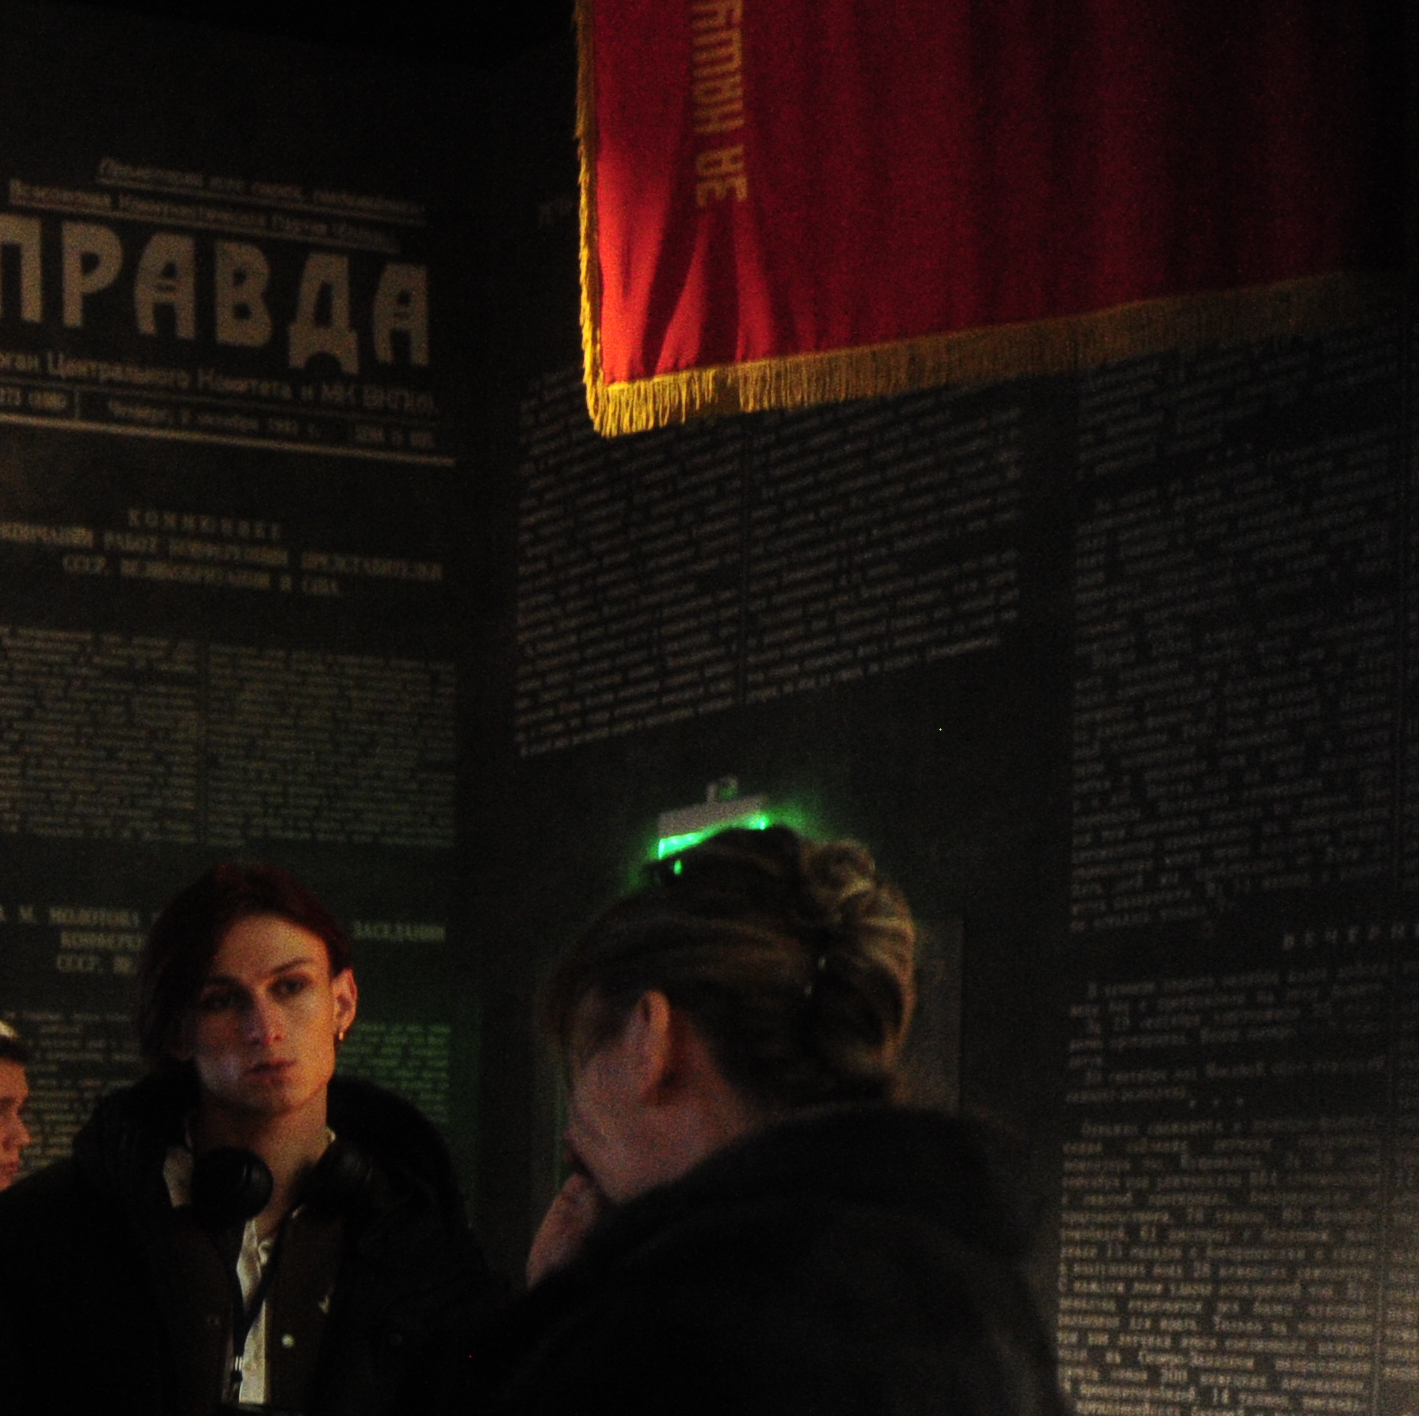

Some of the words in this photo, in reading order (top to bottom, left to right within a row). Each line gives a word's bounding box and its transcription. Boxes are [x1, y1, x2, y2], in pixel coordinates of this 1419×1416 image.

[695, 145, 748, 208] ЗА
[48, 350, 191, 392] Центрального
[197, 367, 293, 400] Комитета
